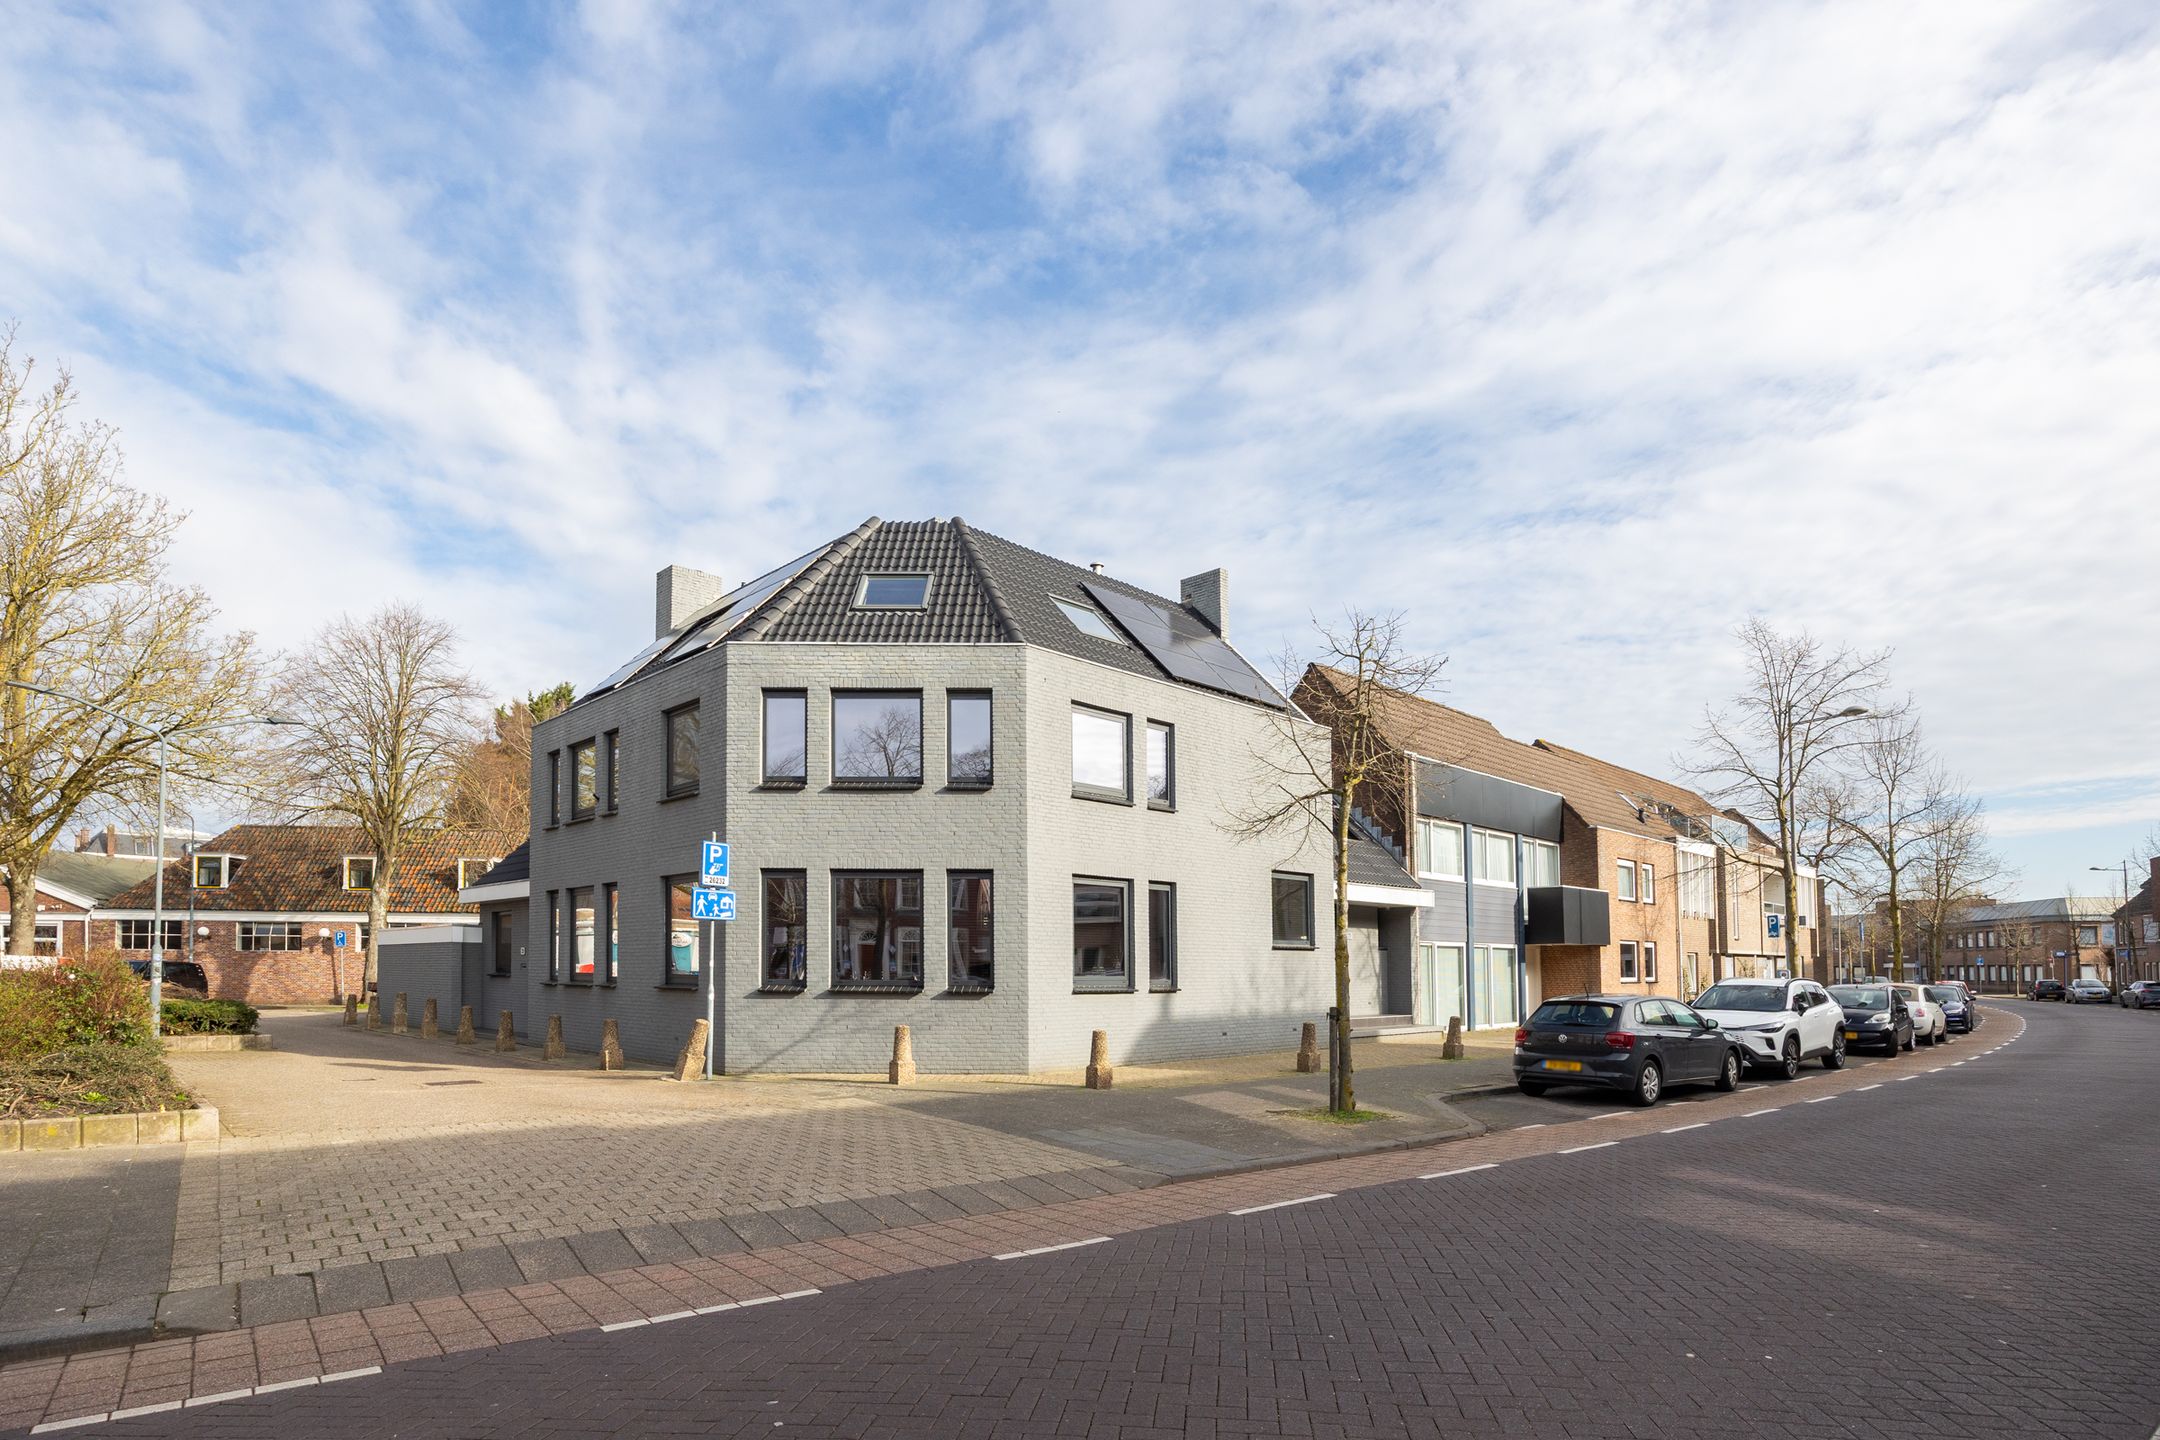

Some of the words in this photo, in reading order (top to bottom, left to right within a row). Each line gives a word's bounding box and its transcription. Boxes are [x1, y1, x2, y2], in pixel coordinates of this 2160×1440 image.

[710, 845, 722, 863] P
[1769, 917, 1777, 928] P
[337, 932, 343, 940] P
